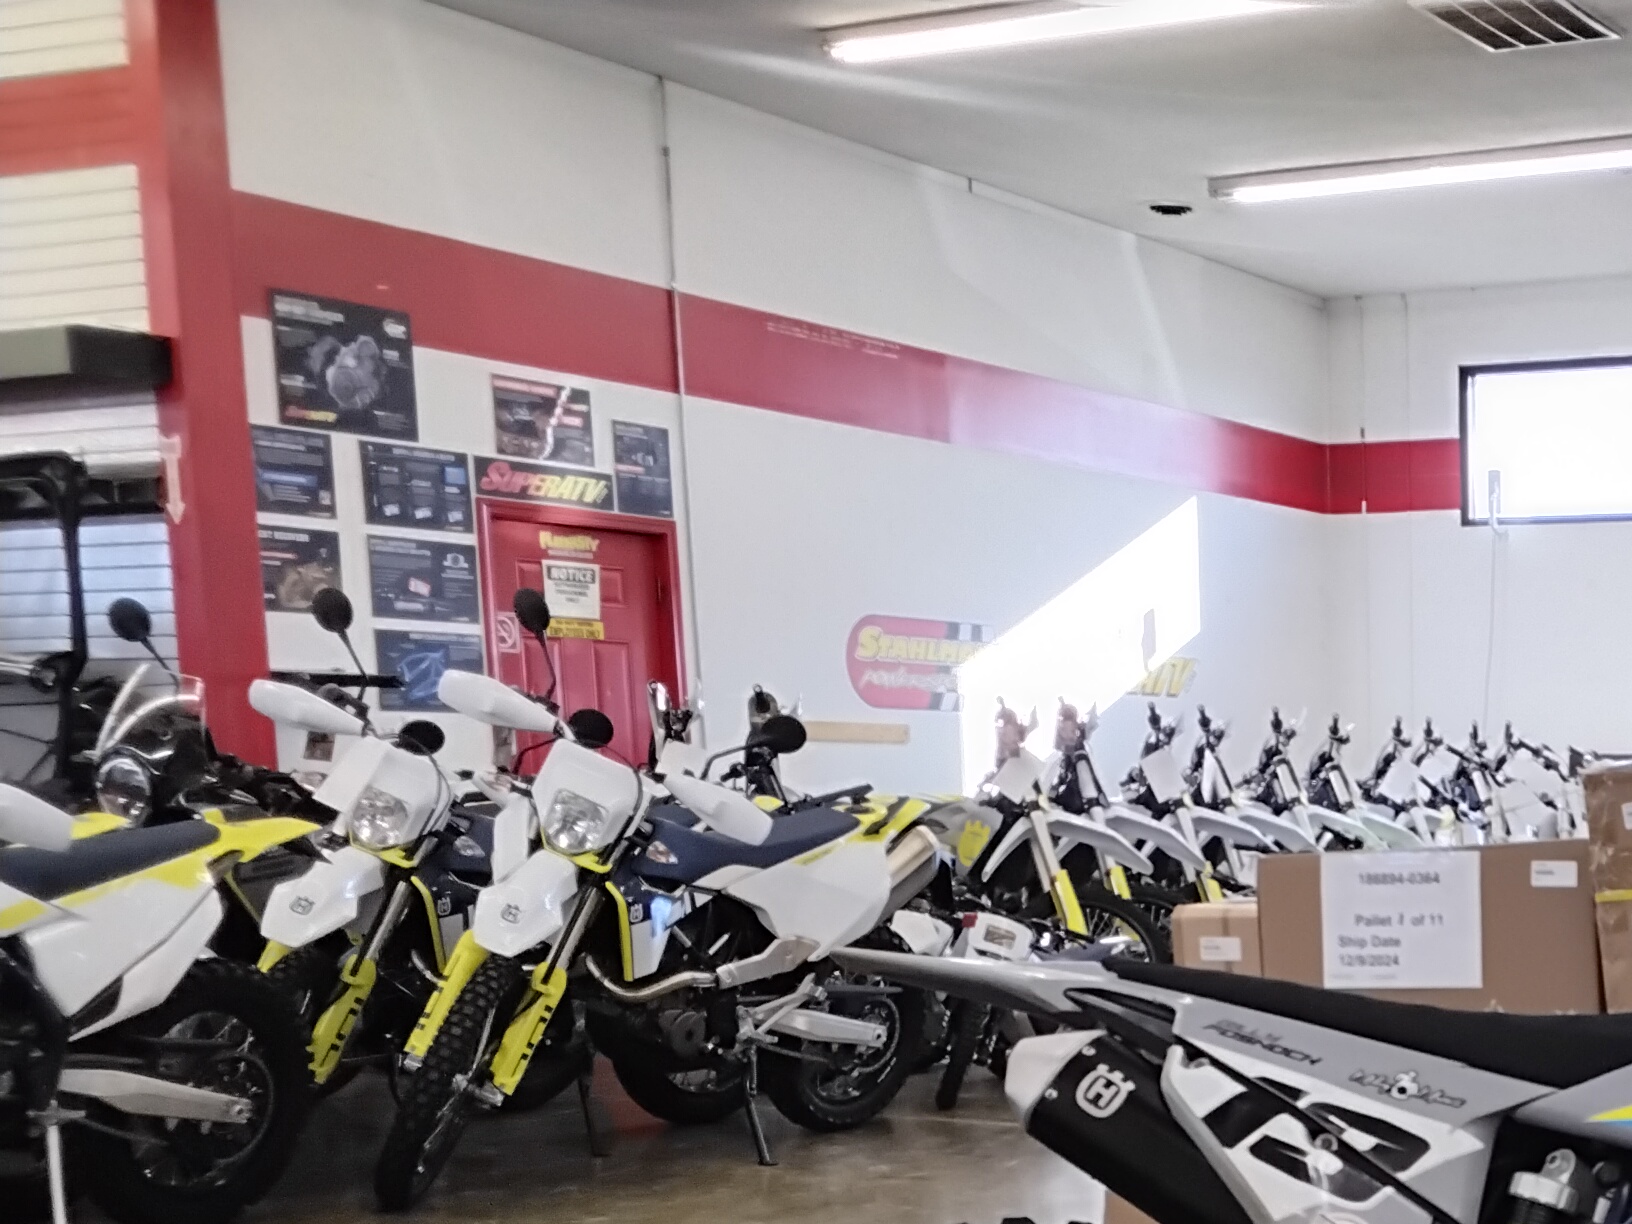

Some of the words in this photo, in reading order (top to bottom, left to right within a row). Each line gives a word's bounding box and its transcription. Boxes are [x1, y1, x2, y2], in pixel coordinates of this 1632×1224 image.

[549, 567, 594, 582] NOTICE
[1354, 914, 1392, 926] Pallet
[1410, 914, 1425, 926] of
[1338, 935, 1368, 949] Ship
[1370, 935, 1401, 948] Date
